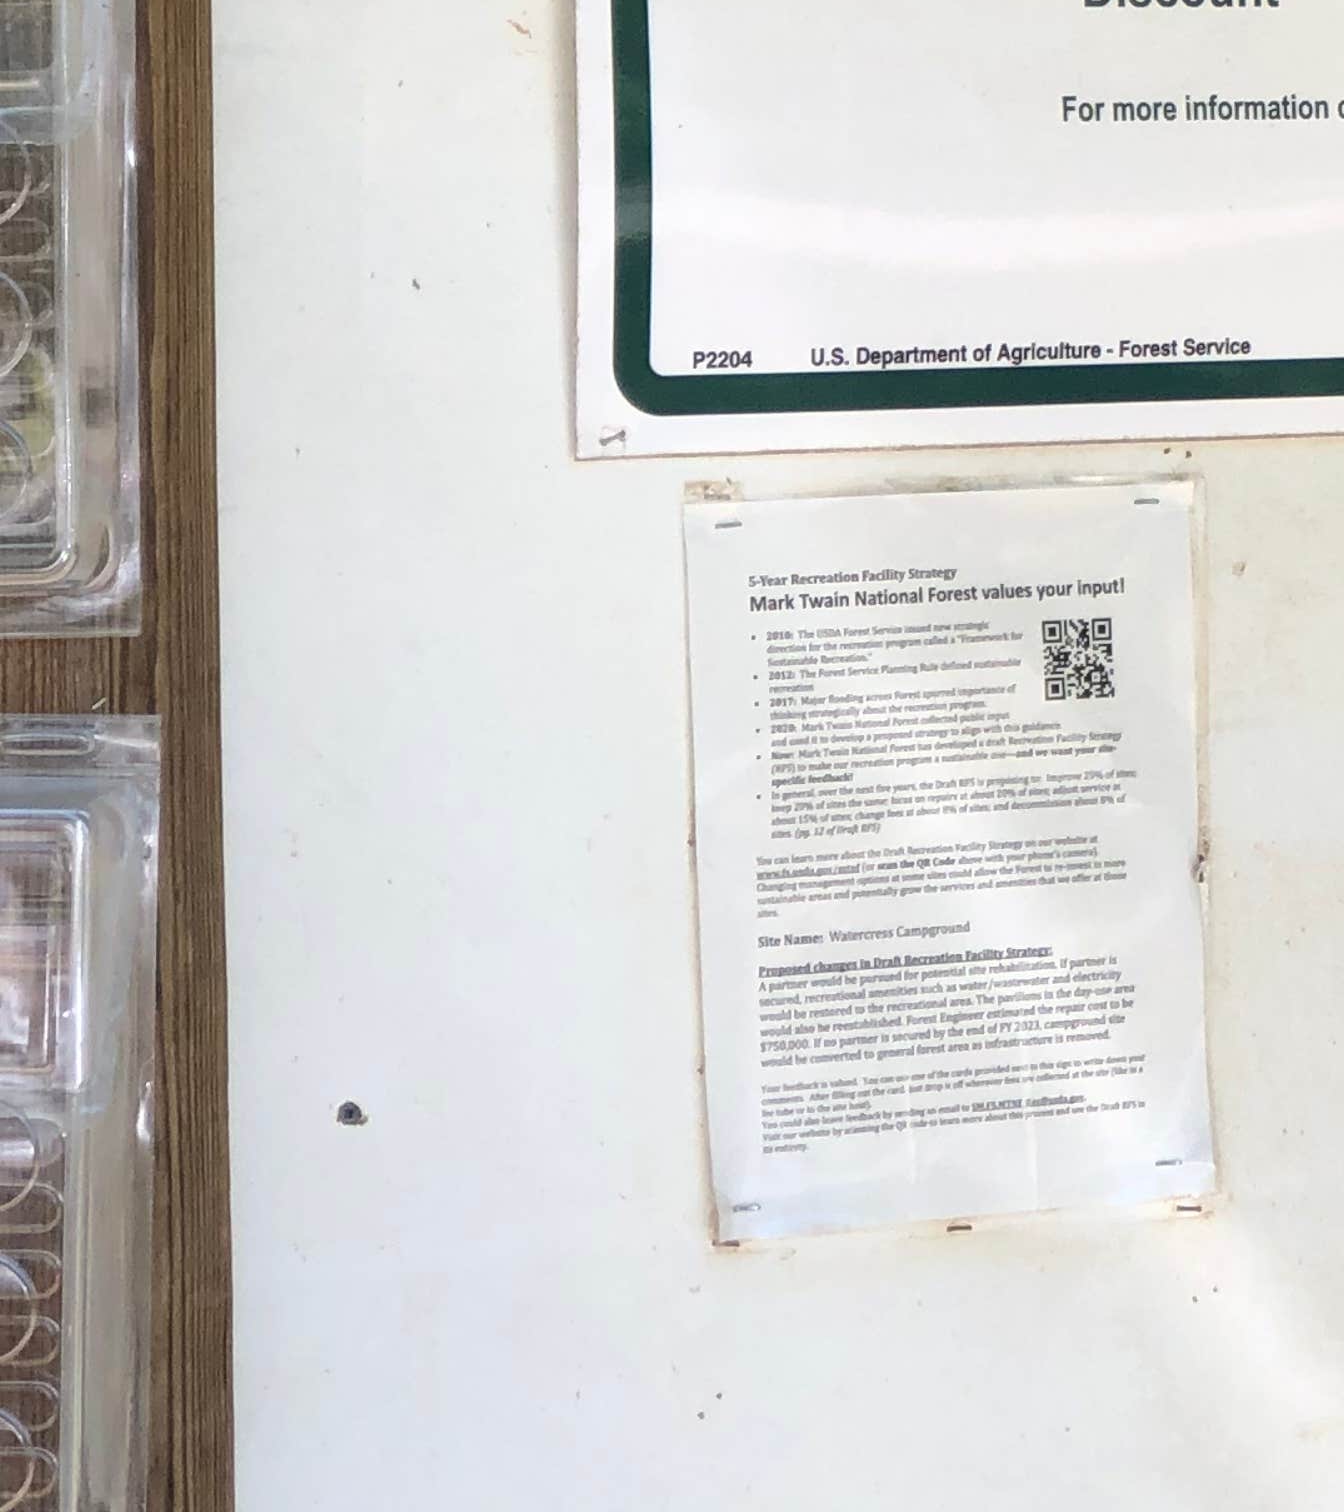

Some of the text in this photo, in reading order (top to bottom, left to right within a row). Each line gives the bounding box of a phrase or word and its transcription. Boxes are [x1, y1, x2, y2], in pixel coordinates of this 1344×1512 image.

[1060, 94, 1105, 123] For
[1111, 99, 1177, 123] more
[1183, 93, 1330, 123] information
[691, 337, 1252, 371] P2204 U.S. Department of Agriculture Forest Service
[748, 566, 958, 588] 5-Year Recreation Facility Strategy
[749, 576, 1126, 613] Mark Twain National Forest values your input!
[757, 920, 971, 950] Site Name: Watercress Campground
[758, 964, 812, 979] Proposed
[812, 961, 858, 975] changes
[859, 958, 872, 972] in
[873, 956, 901, 971] Draft
[904, 950, 963, 967] Recreation
[964, 947, 1004, 963] Facility
